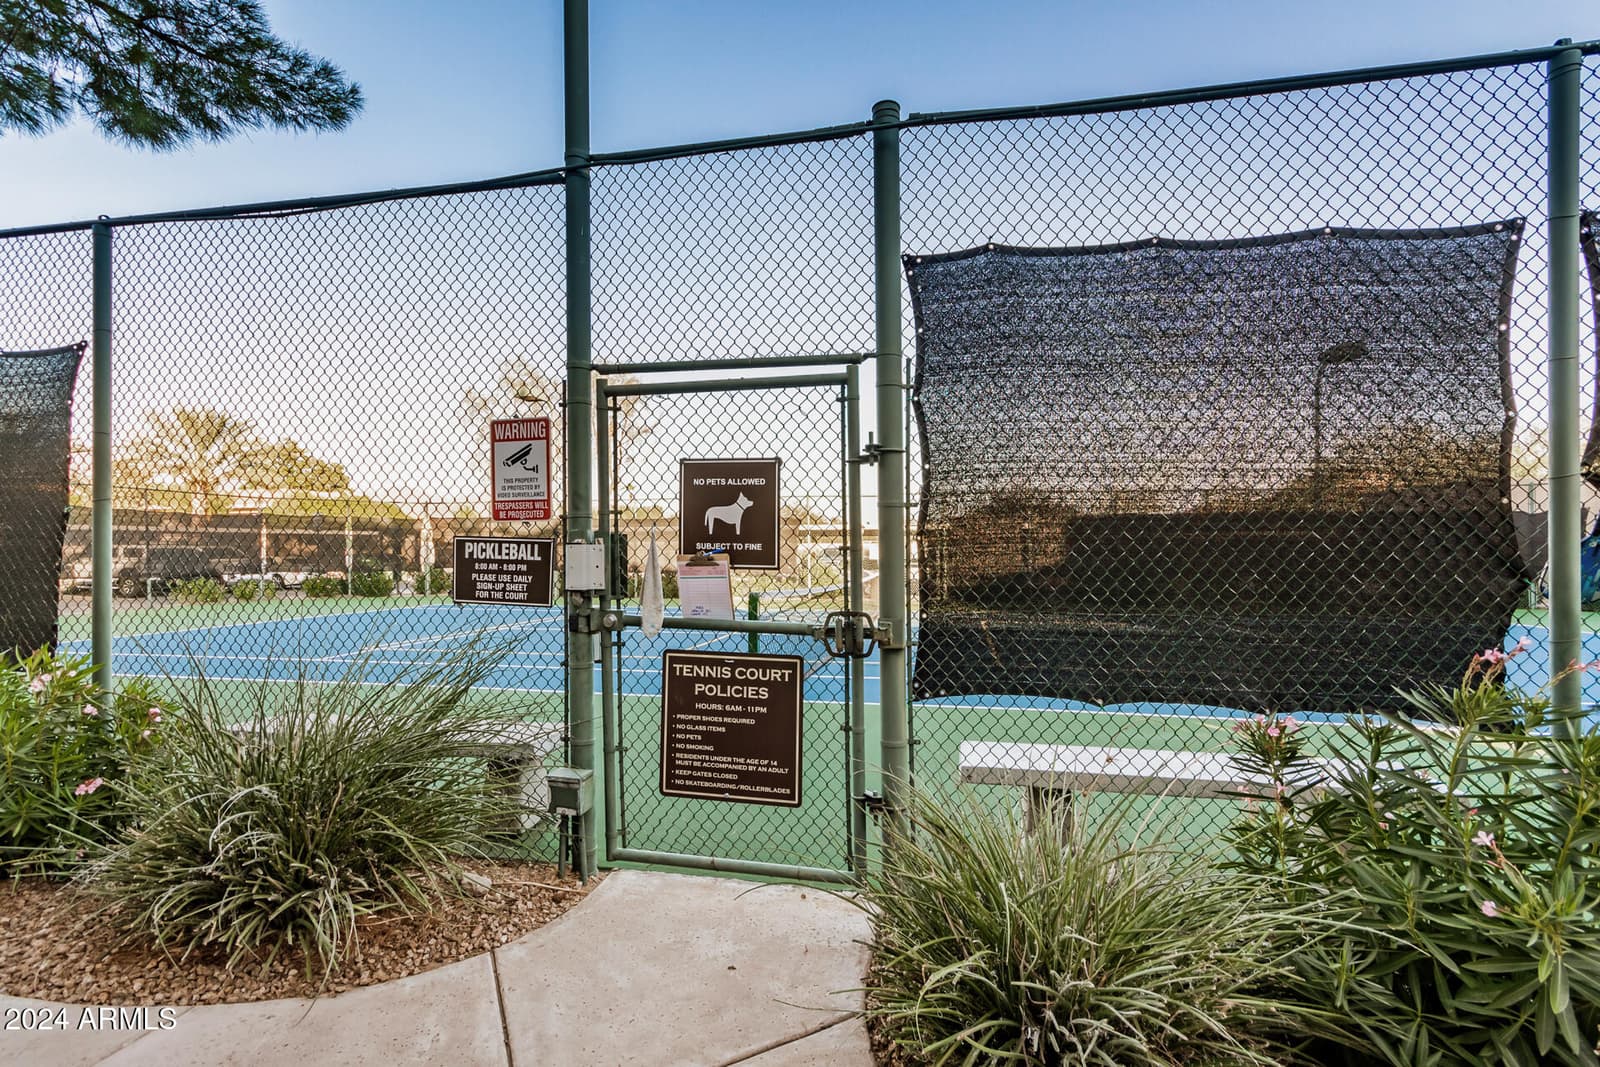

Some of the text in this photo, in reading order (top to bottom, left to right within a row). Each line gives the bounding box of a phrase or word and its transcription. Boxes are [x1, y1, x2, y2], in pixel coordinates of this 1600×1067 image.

[494, 421, 546, 440] WARNING
[494, 501, 549, 510] TRESPASSERS WILL
[500, 510, 544, 519] BE PROSECUTED
[464, 542, 542, 560] PICKLEBALL
[505, 592, 528, 600] COURT
[673, 664, 792, 682] TENNIS COURT
[695, 684, 768, 699] POLICIES
[696, 702, 724, 710] HOURS:
[702, 762, 748, 770] ACCOMPANIED
[685, 780, 790, 794] SKATEBOARDING/ROLLERBLADES
